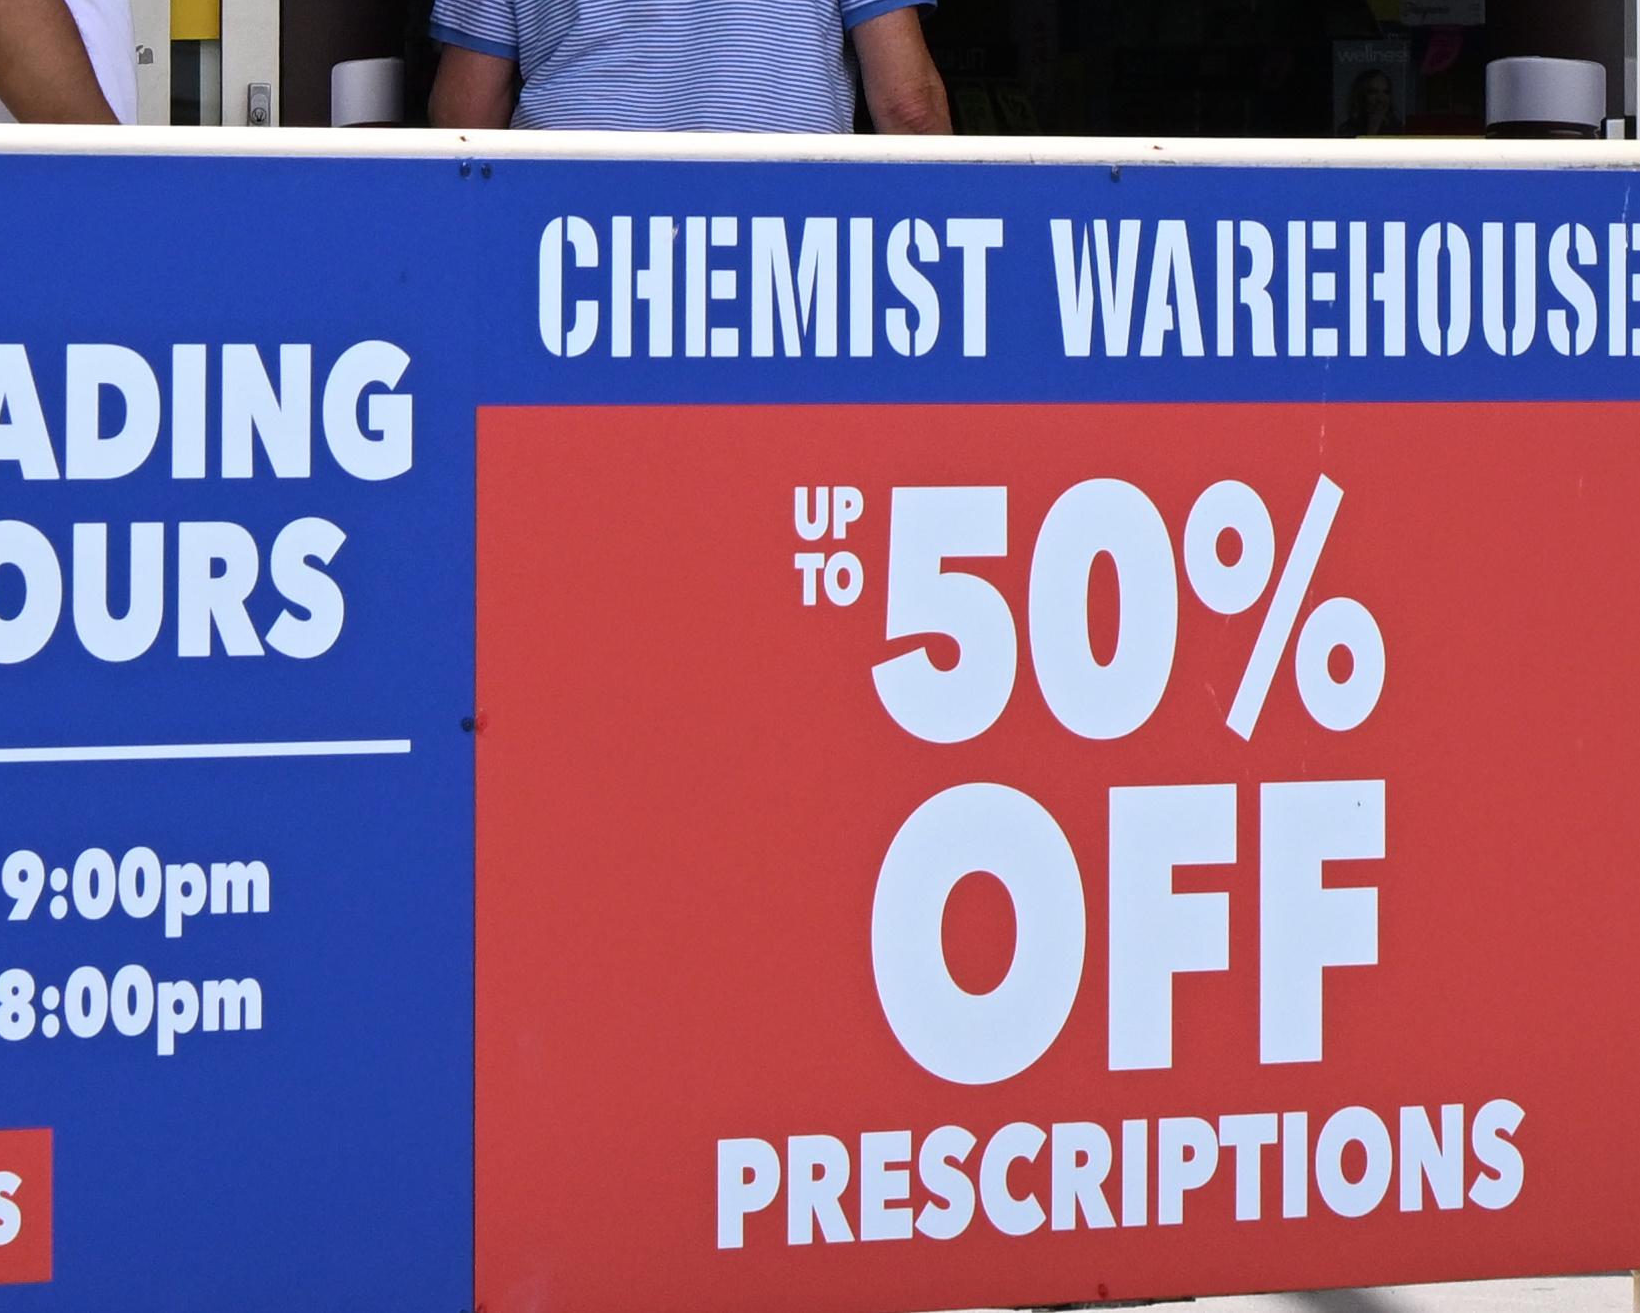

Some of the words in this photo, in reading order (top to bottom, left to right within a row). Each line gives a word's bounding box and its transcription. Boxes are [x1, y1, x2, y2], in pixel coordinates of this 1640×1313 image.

[537, 215, 1004, 359] CHEMIST
[793, 551, 864, 607] TO
[793, 485, 864, 542] UP
[870, 472, 1386, 744] 50%
[0, 845, 271, 940] 9:00pm
[870, 779, 1386, 1086] OFF
[716, 1098, 1526, 1250] PRESCRIPTIONS
